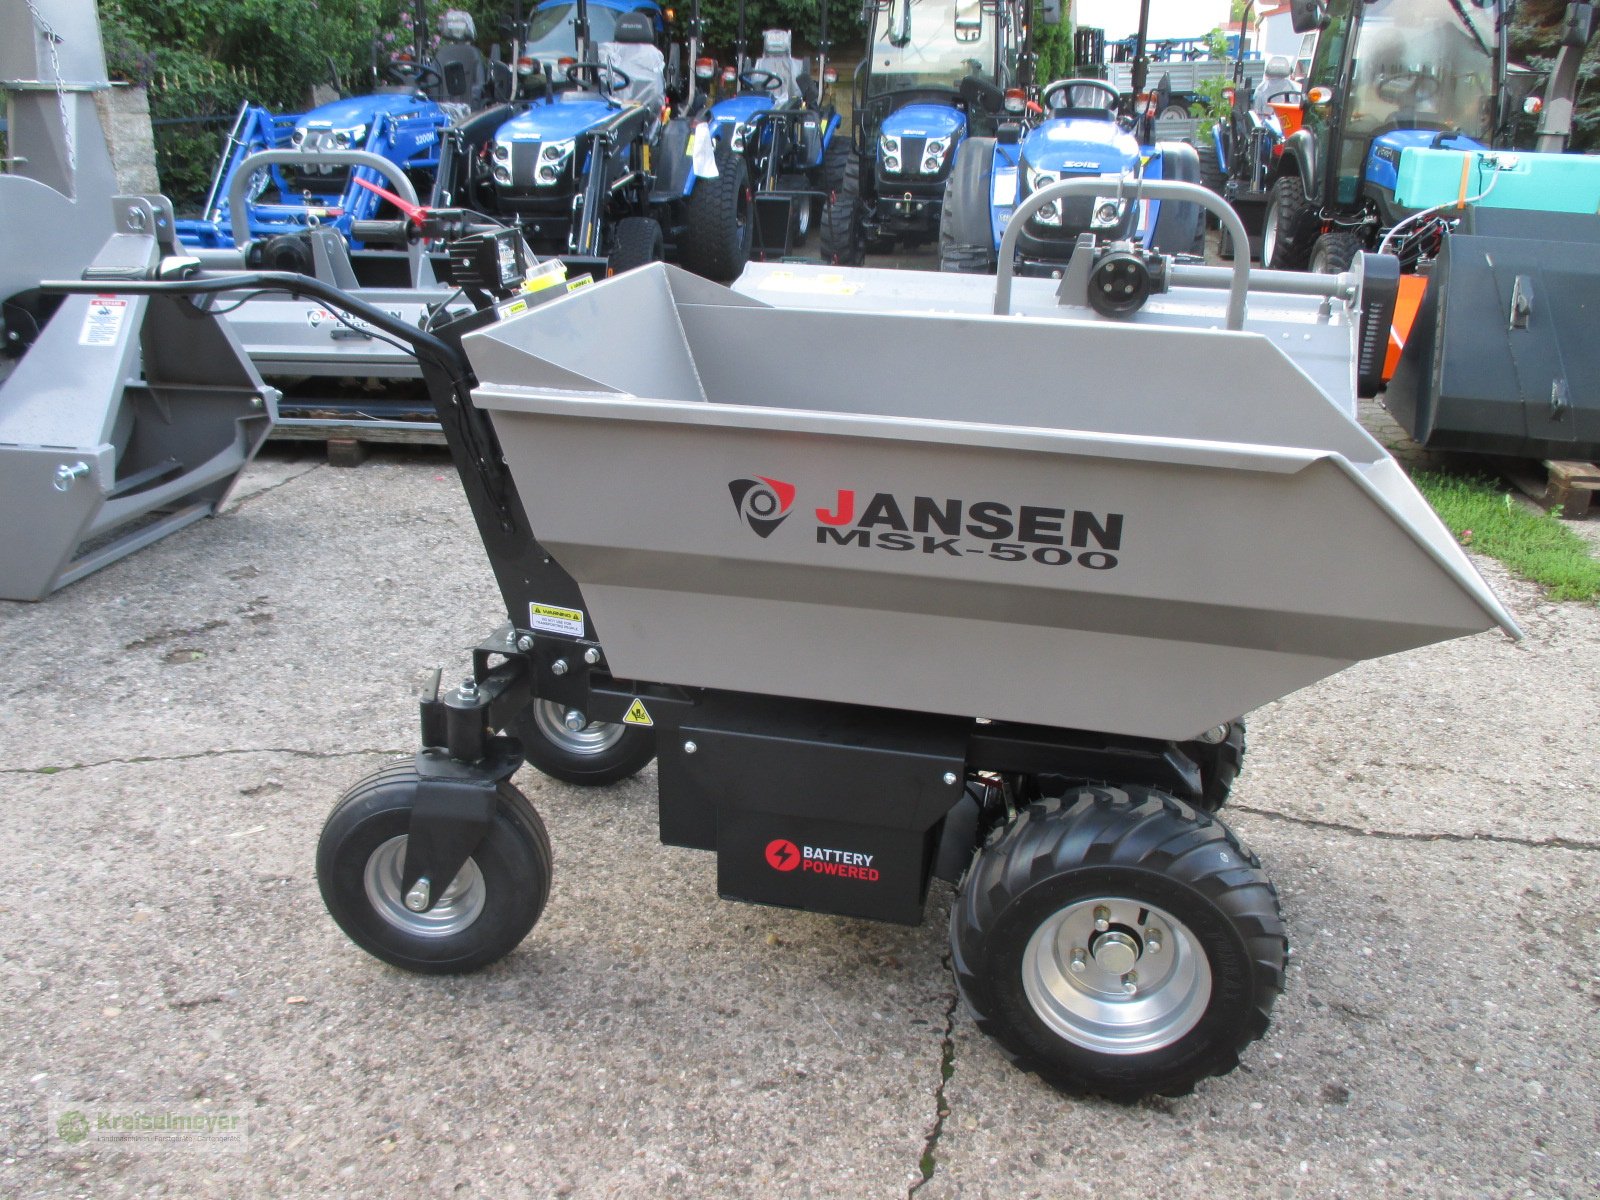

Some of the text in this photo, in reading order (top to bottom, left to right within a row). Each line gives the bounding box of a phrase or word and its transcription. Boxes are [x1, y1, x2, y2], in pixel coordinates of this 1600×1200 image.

[815, 489, 1124, 551] JANSEN
[816, 526, 1119, 570] MSK-500
[543, 609, 572, 618] WARNING
[803, 845, 873, 867] BATTERY
[803, 860, 879, 881] POWERED
